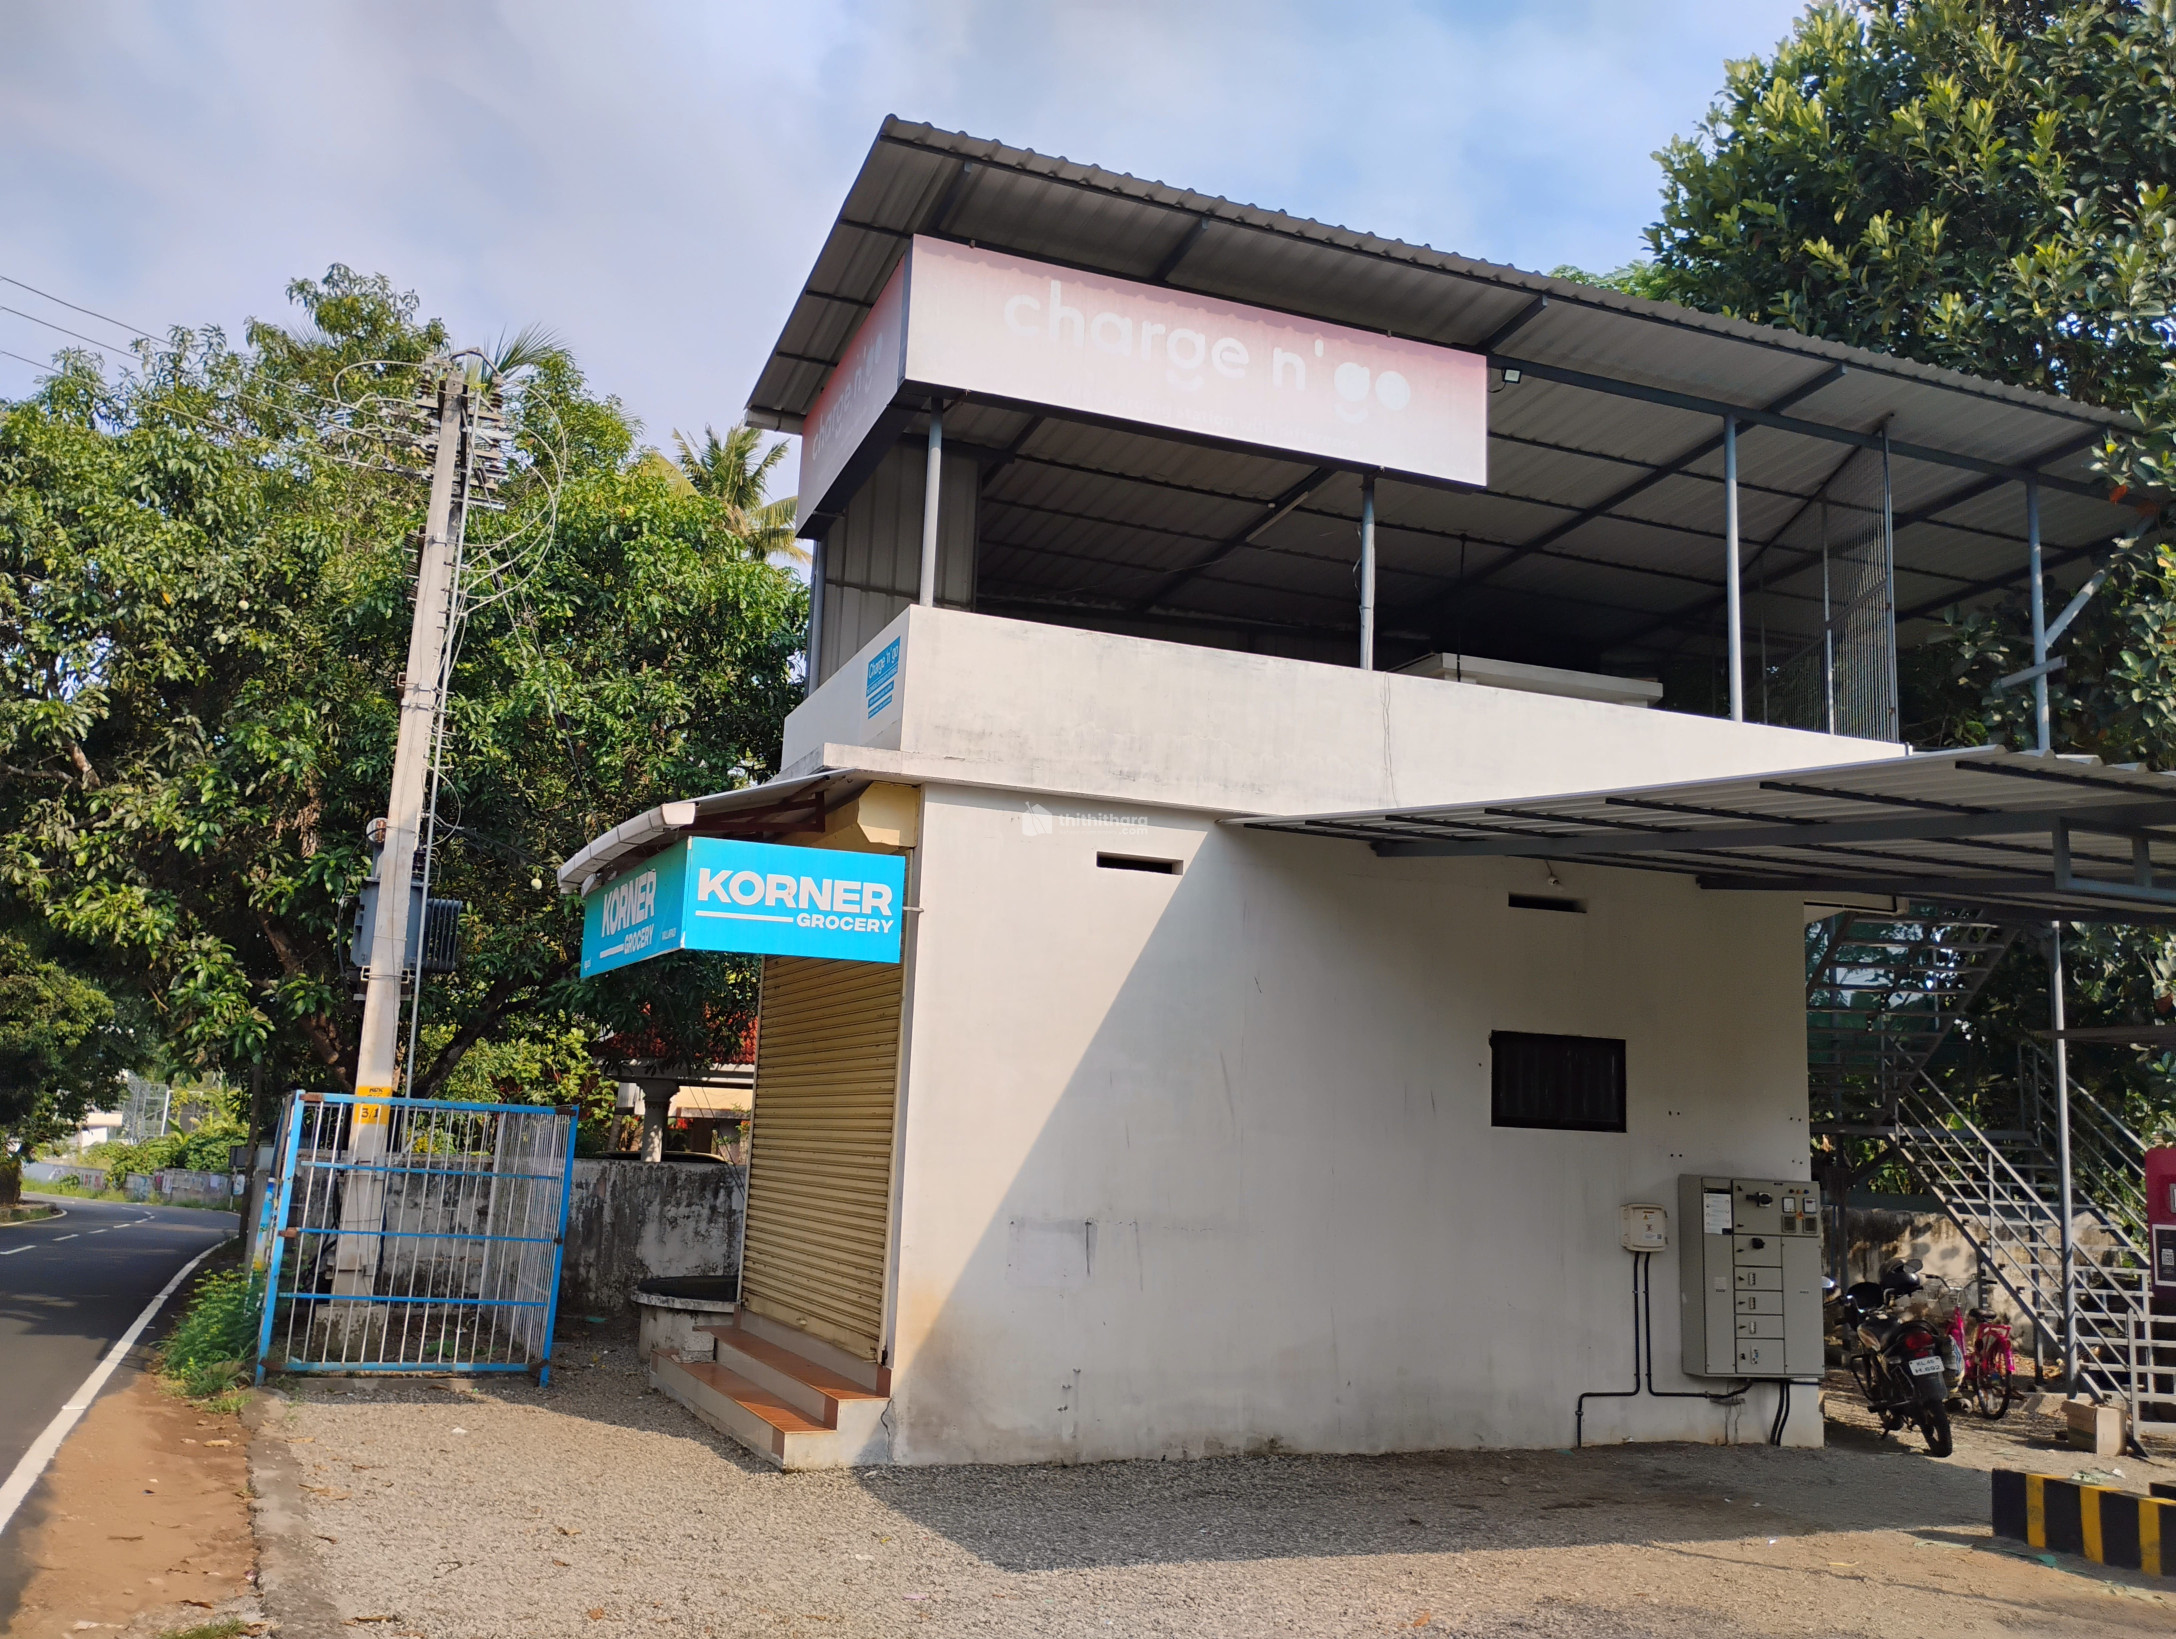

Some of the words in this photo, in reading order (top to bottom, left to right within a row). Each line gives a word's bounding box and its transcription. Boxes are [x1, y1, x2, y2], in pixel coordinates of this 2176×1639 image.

[1003, 280, 1250, 392] charge
[1272, 338, 1324, 391] n'
[1333, 361, 1411, 424] go
[812, 383, 851, 461] charge
[601, 869, 657, 938] KORNER
[696, 868, 892, 916] KORNER
[624, 924, 655, 954] GROCERY
[796, 912, 894, 934] GROCERY
